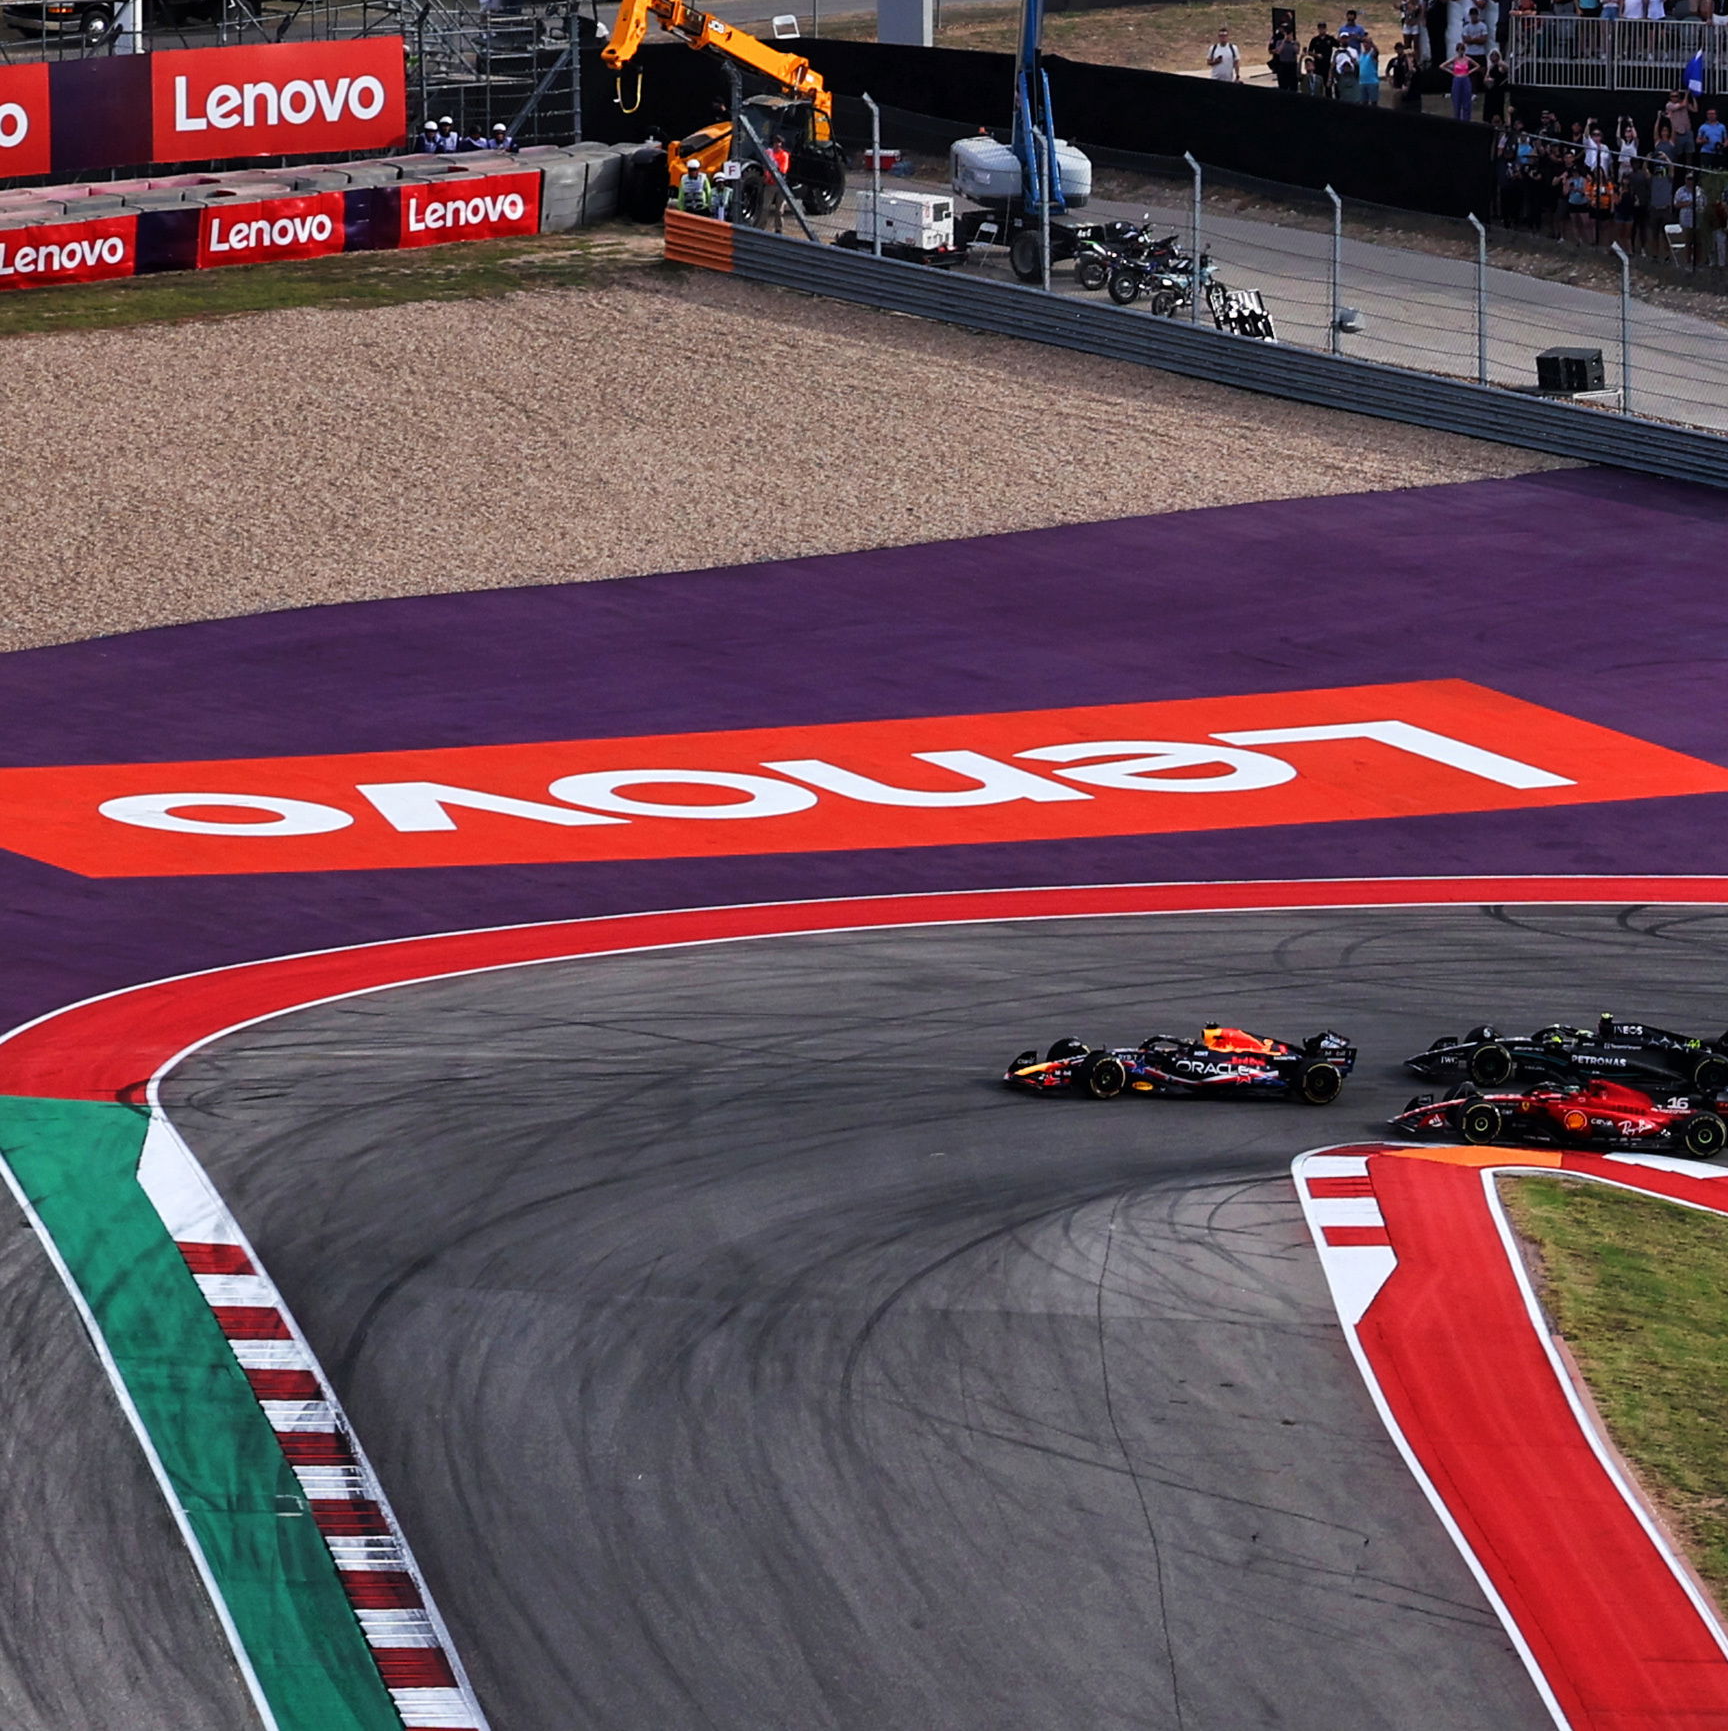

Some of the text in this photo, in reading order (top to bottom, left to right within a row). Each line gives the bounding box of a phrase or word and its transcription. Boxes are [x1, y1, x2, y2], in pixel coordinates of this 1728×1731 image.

[174, 75, 385, 132] Lenovo
[728, 165, 736, 176] F
[408, 192, 525, 232] Lenovo
[209, 213, 333, 252] Lenovo
[0, 236, 125, 274] Lenovo
[98, 719, 1578, 837] Lenovo
[1176, 1059, 1250, 1076] ORACLE
[1571, 1054, 1627, 1067] PETRONAS
[1667, 1097, 1689, 1109] 16
